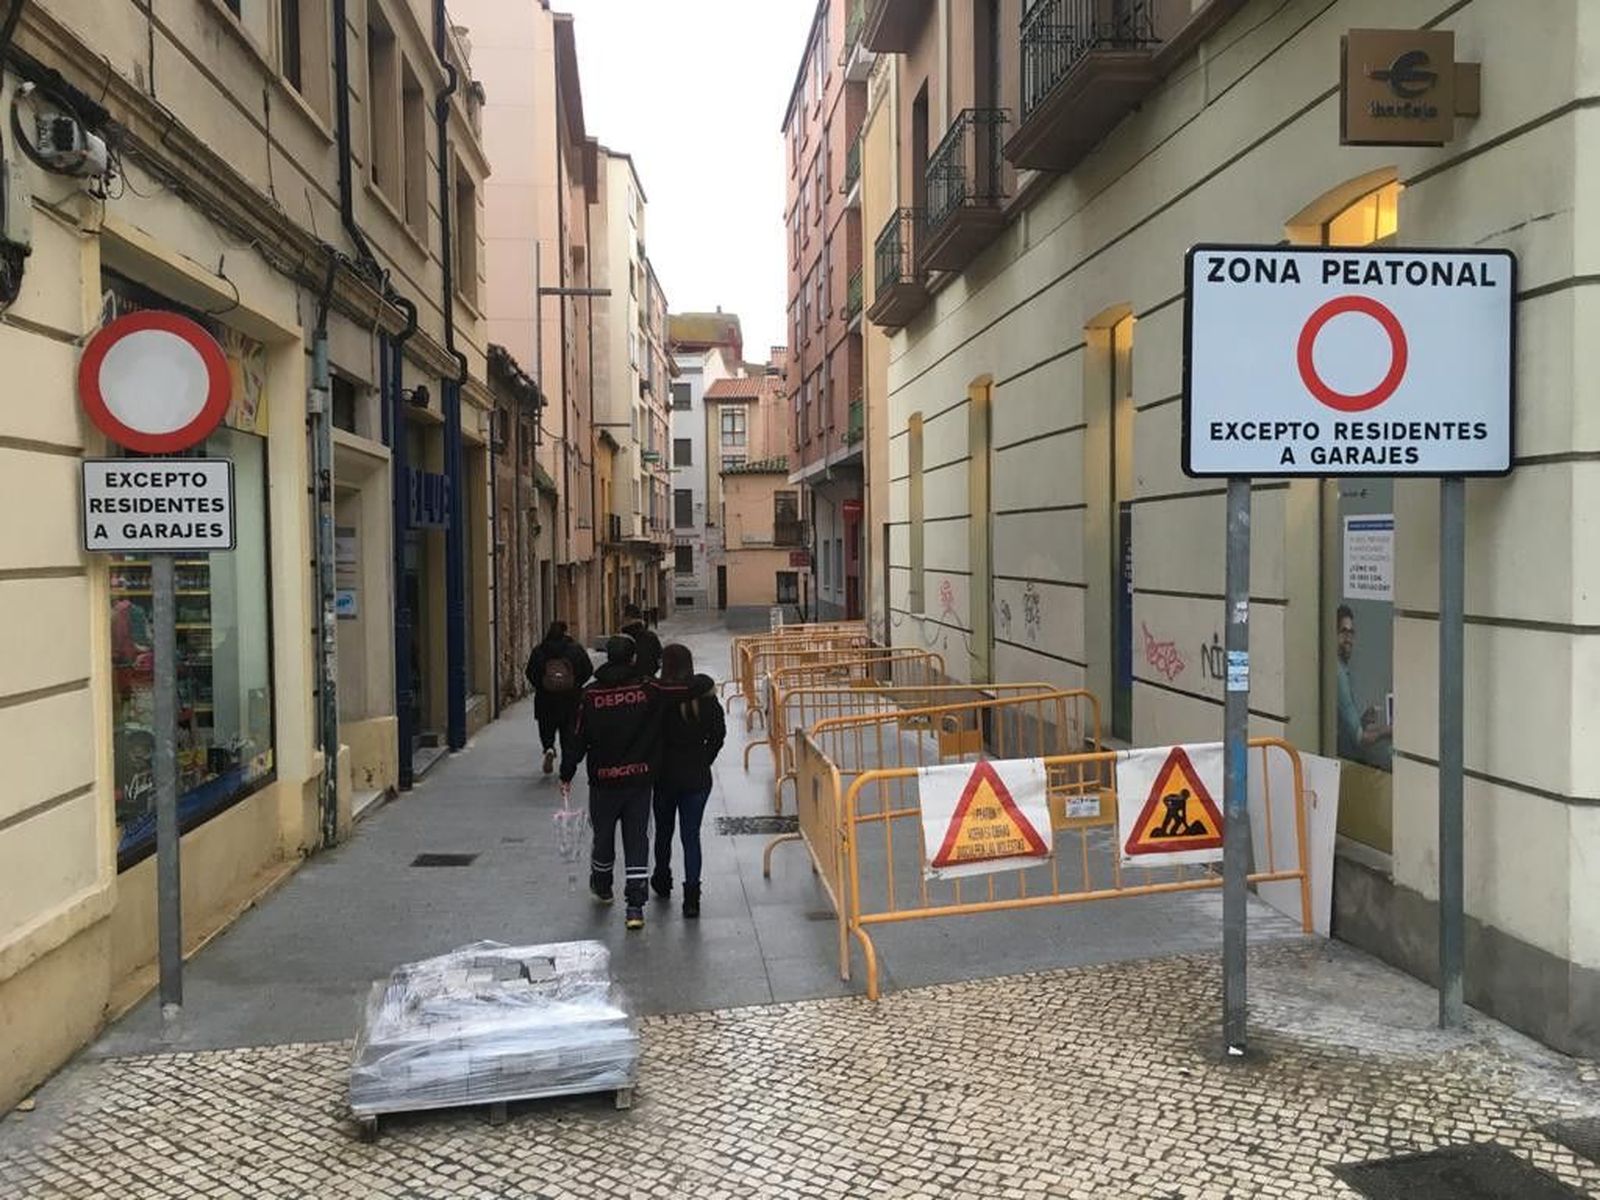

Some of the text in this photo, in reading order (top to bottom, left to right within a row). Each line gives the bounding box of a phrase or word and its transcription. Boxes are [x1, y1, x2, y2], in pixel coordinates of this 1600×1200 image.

[1207, 257, 1496, 287] ZONA PEATONAL
[1210, 422, 1488, 441] EXCEPTO RESIDENTES
[1280, 446, 1419, 465] A GARAJES
[105, 472, 207, 488] EXCEPTO
[89, 498, 224, 513] RESIDENTES
[93, 523, 223, 539] A GARAJES
